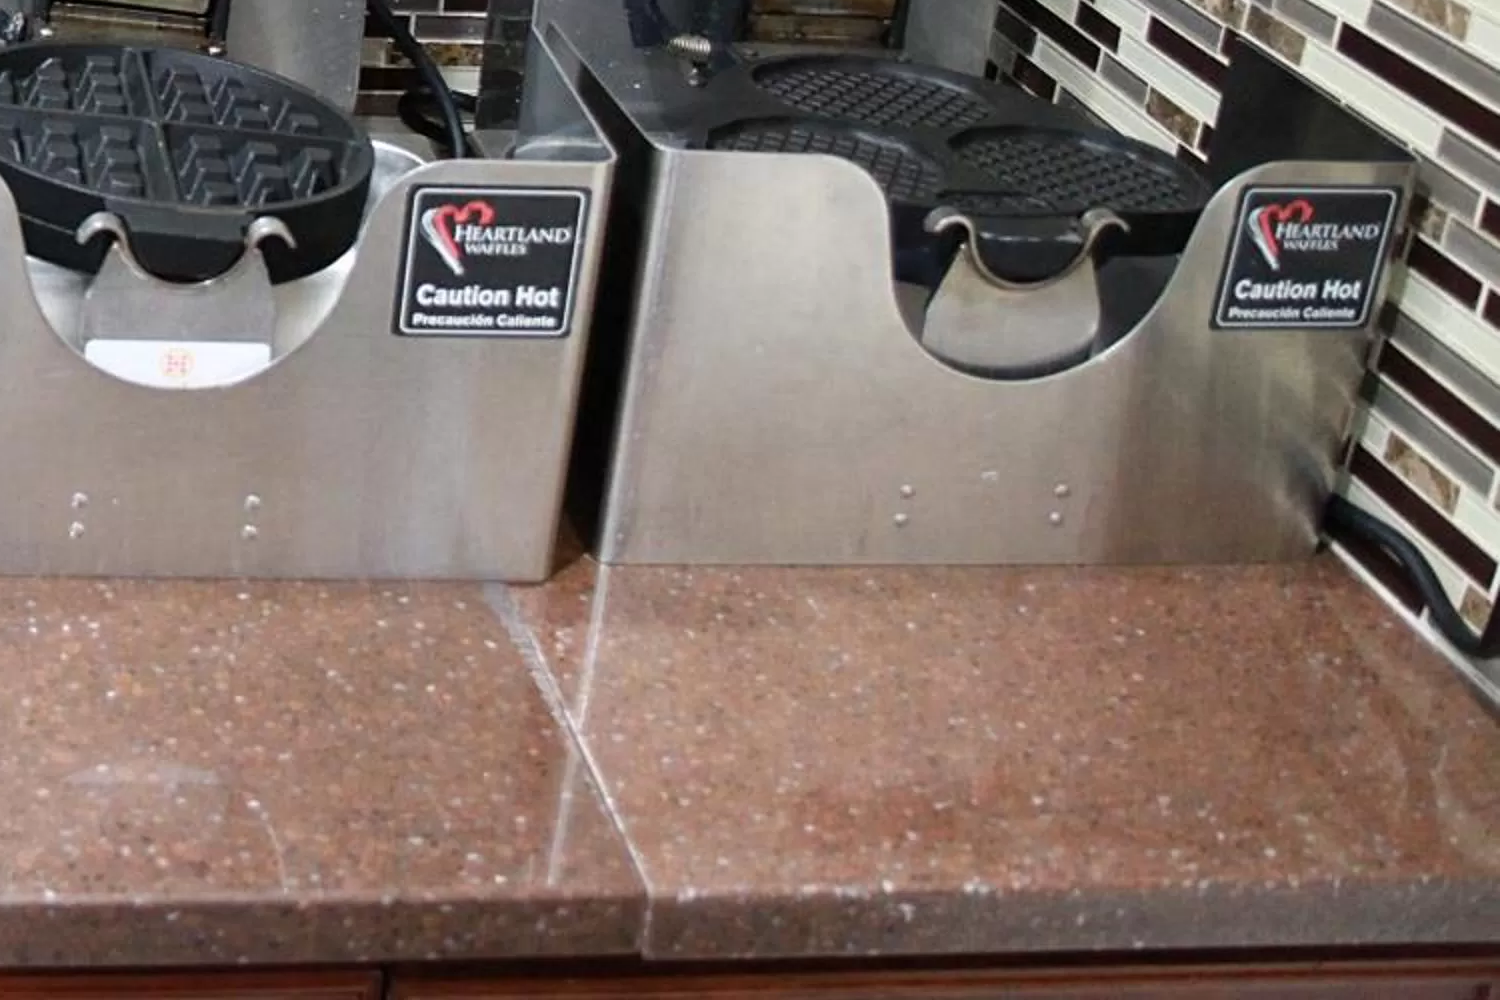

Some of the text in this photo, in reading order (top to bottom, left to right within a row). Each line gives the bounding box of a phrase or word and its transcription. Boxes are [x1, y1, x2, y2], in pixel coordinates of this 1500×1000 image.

[454, 224, 572, 244] HEARTLAND
[1275, 222, 1381, 240] HEARTLAND
[464, 242, 528, 256] WAFFLES
[415, 283, 561, 307] Caution Hot
[1234, 279, 1363, 300] Caution Hot
[411, 312, 558, 328] Precaución Caliente
[1302, 307, 1356, 320] Caliente
